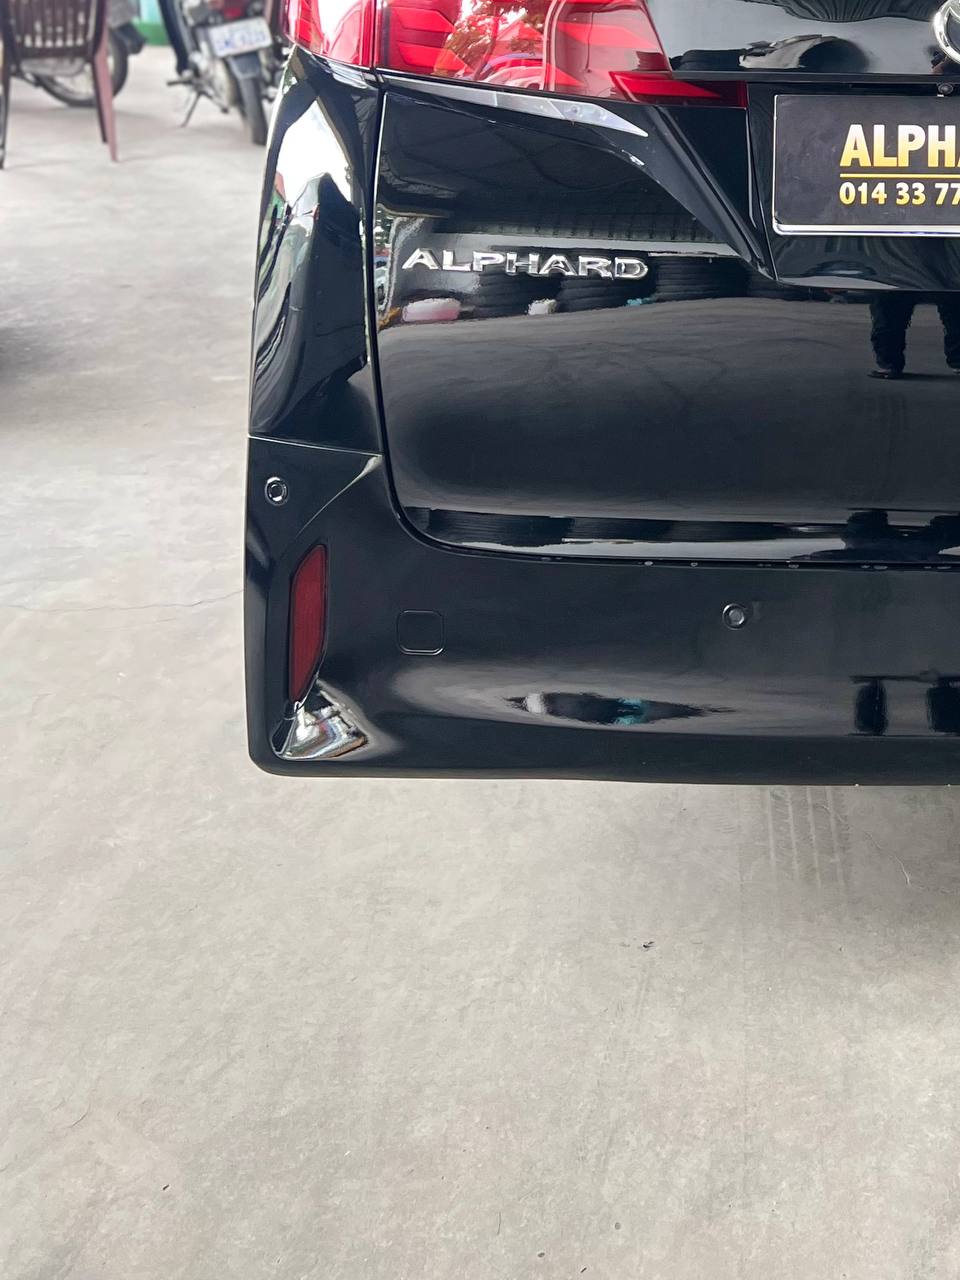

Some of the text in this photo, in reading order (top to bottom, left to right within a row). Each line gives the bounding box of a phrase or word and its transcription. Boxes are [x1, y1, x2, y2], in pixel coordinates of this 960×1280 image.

[838, 181, 888, 206] 014
[896, 182, 927, 206] 33
[401, 247, 649, 281] ALPHARD
